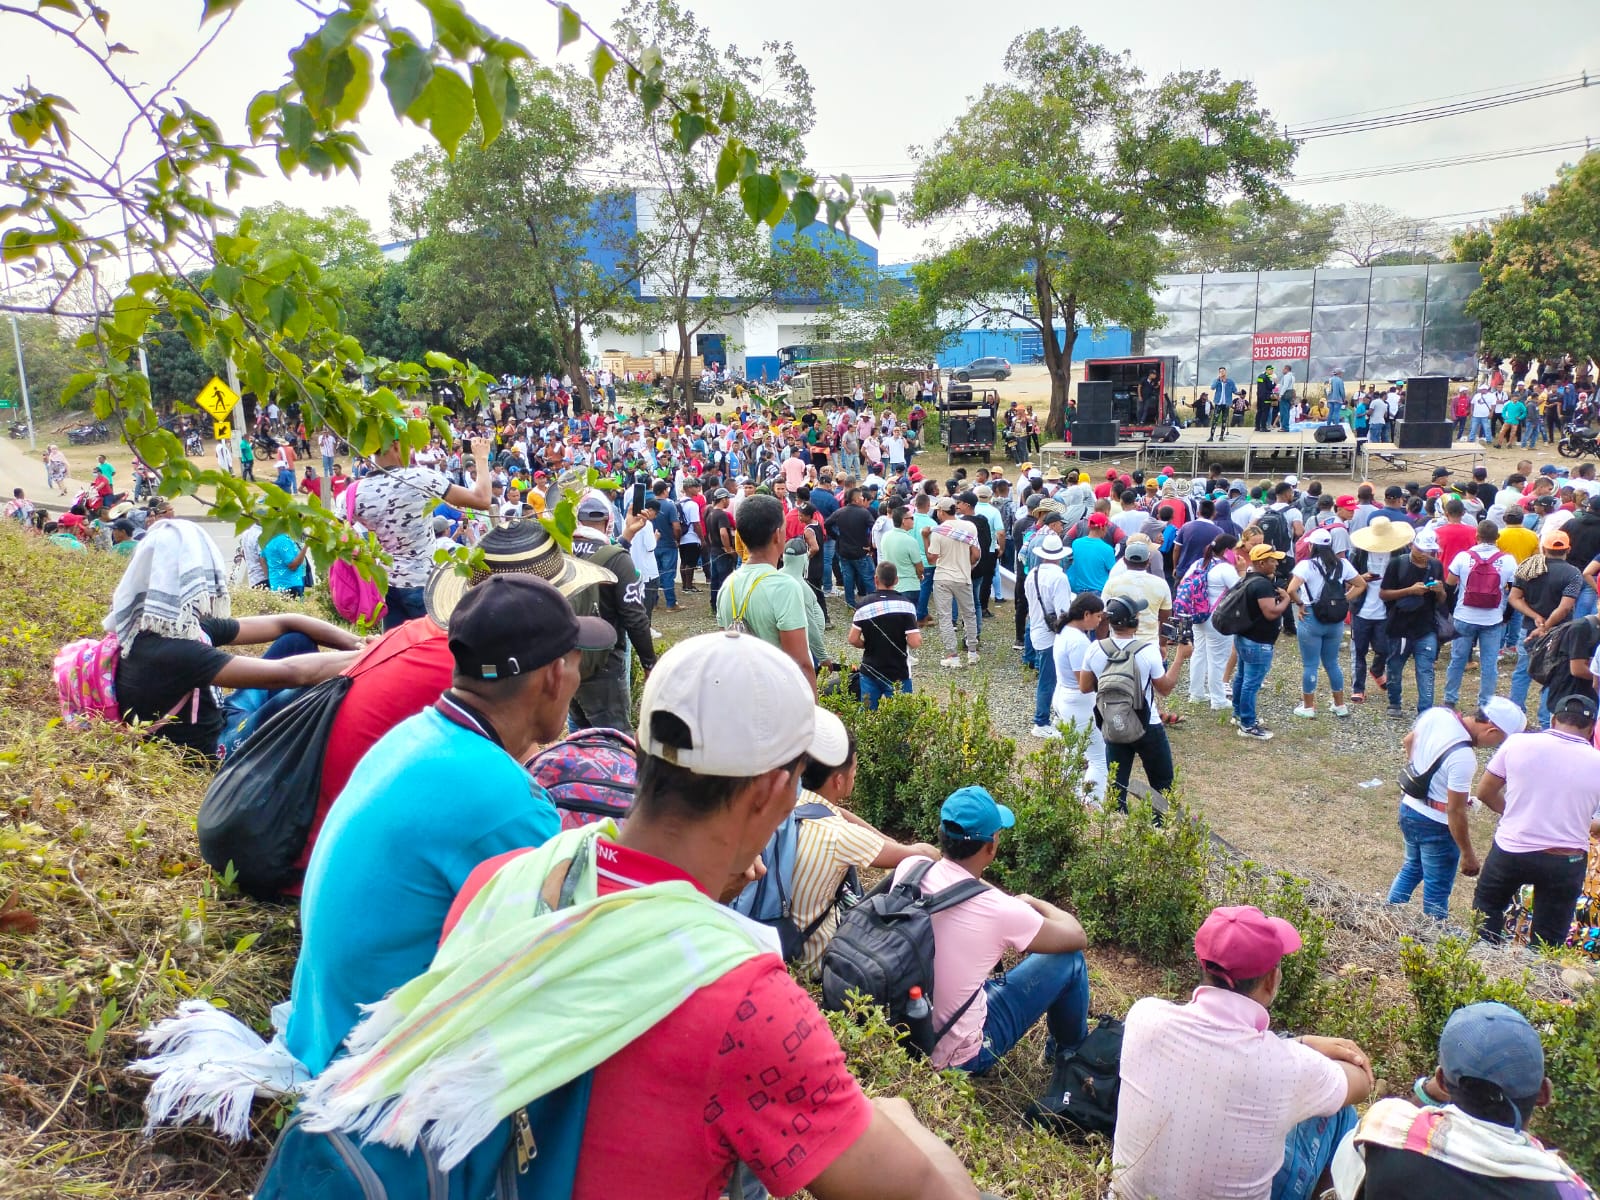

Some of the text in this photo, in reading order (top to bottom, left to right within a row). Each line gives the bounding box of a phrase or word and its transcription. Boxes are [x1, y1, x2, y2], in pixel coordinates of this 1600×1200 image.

[1254, 336, 1309, 345] VALLA DISPONIBLE
[1254, 346, 1307, 358] 313 3669178
